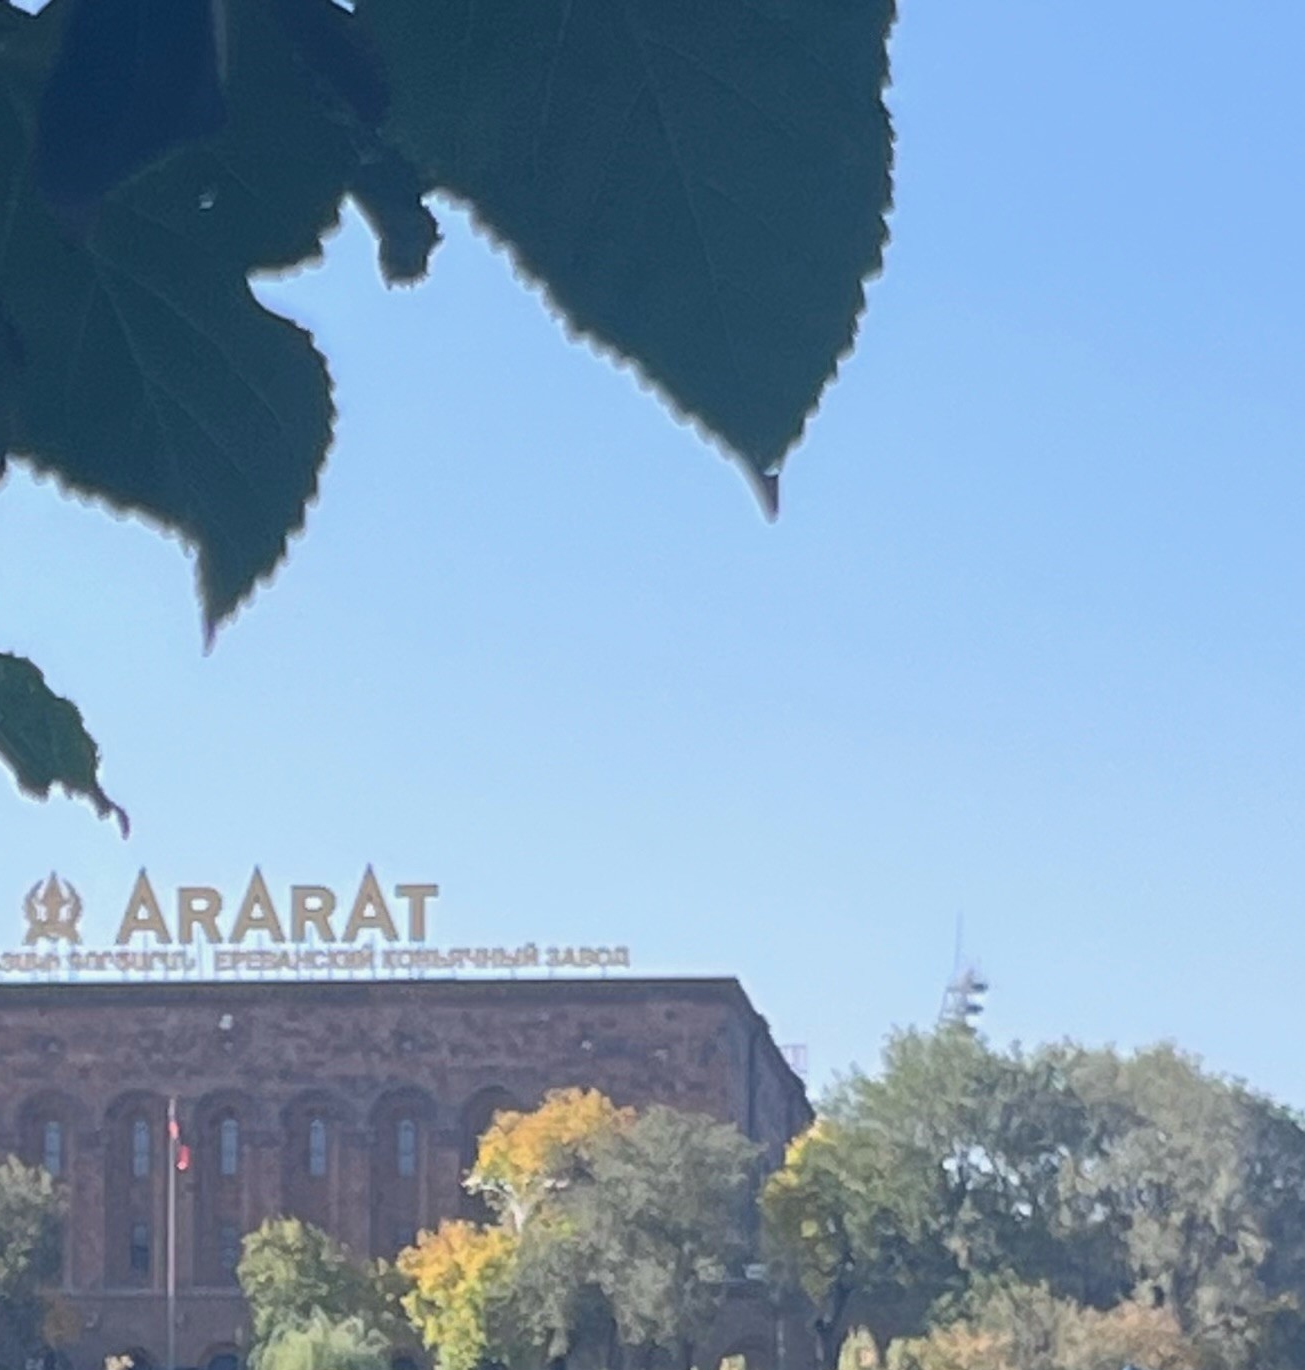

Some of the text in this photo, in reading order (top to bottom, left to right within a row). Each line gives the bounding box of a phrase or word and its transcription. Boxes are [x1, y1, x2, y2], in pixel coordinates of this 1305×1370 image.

[115, 863, 439, 945] ARARAT
[214, 942, 630, 971] ЕРЕВАНСКИЙ КОНЬЯЧНЫЙ ЗАВОД
